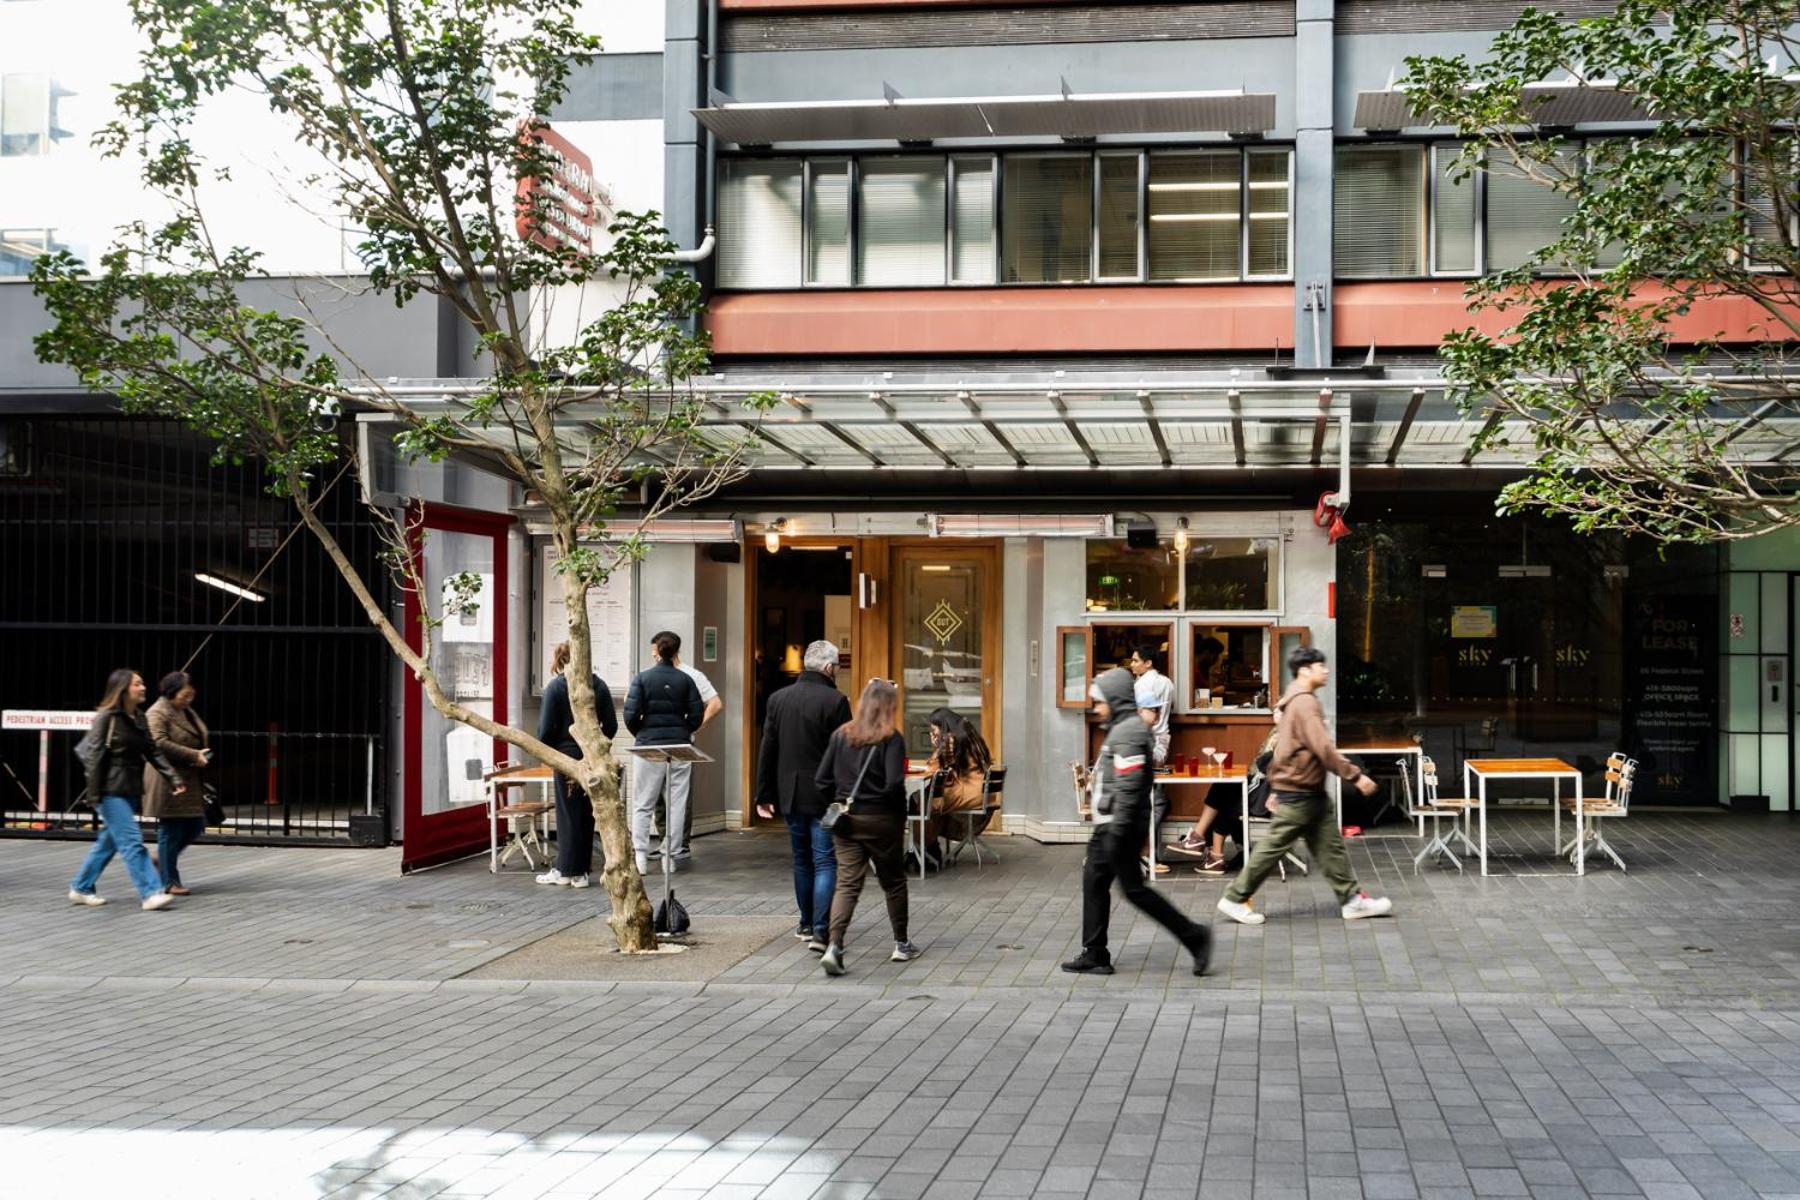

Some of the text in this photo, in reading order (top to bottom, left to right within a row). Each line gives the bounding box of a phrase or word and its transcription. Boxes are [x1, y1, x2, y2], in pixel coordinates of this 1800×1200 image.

[1652, 619, 1688, 632] FOR
[1641, 635, 1698, 650] LEASE
[1458, 643, 1492, 667] sky
[1555, 643, 1590, 667] sky
[7, 715, 45, 724] PEDESTRIAN
[49, 716, 72, 725] ACCESS
